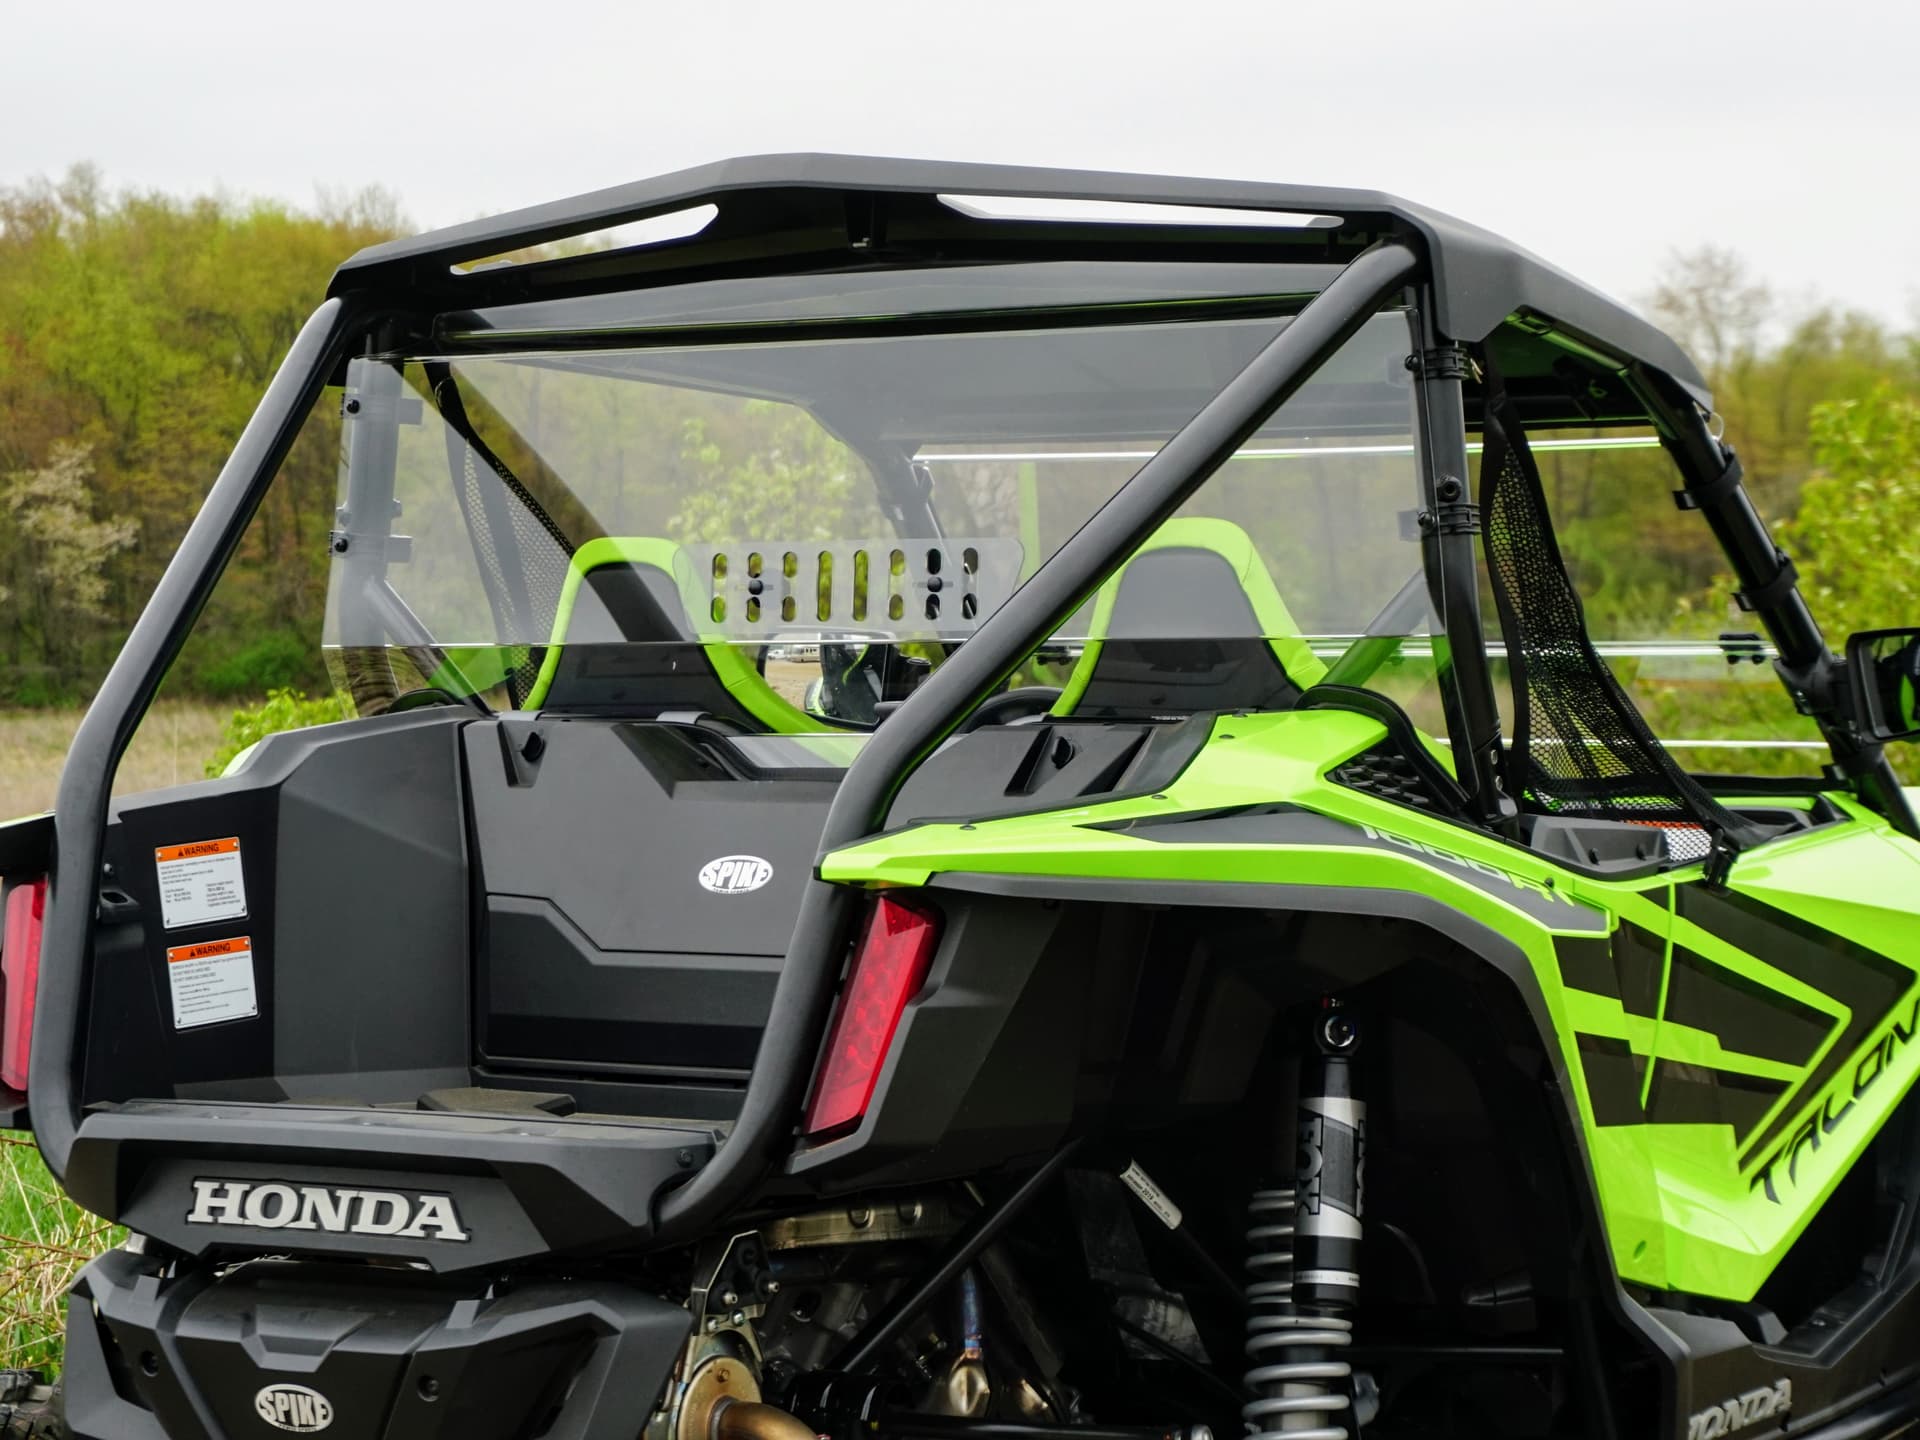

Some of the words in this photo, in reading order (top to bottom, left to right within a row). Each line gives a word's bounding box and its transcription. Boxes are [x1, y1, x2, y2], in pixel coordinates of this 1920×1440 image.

[183, 843, 220, 856] WARNING
[702, 860, 771, 891] SPIKE
[195, 943, 231, 955] WARNING
[1750, 998, 1920, 1205] TALON
[187, 1181, 468, 1241] HONDA
[258, 1390, 331, 1428] SPIKE
